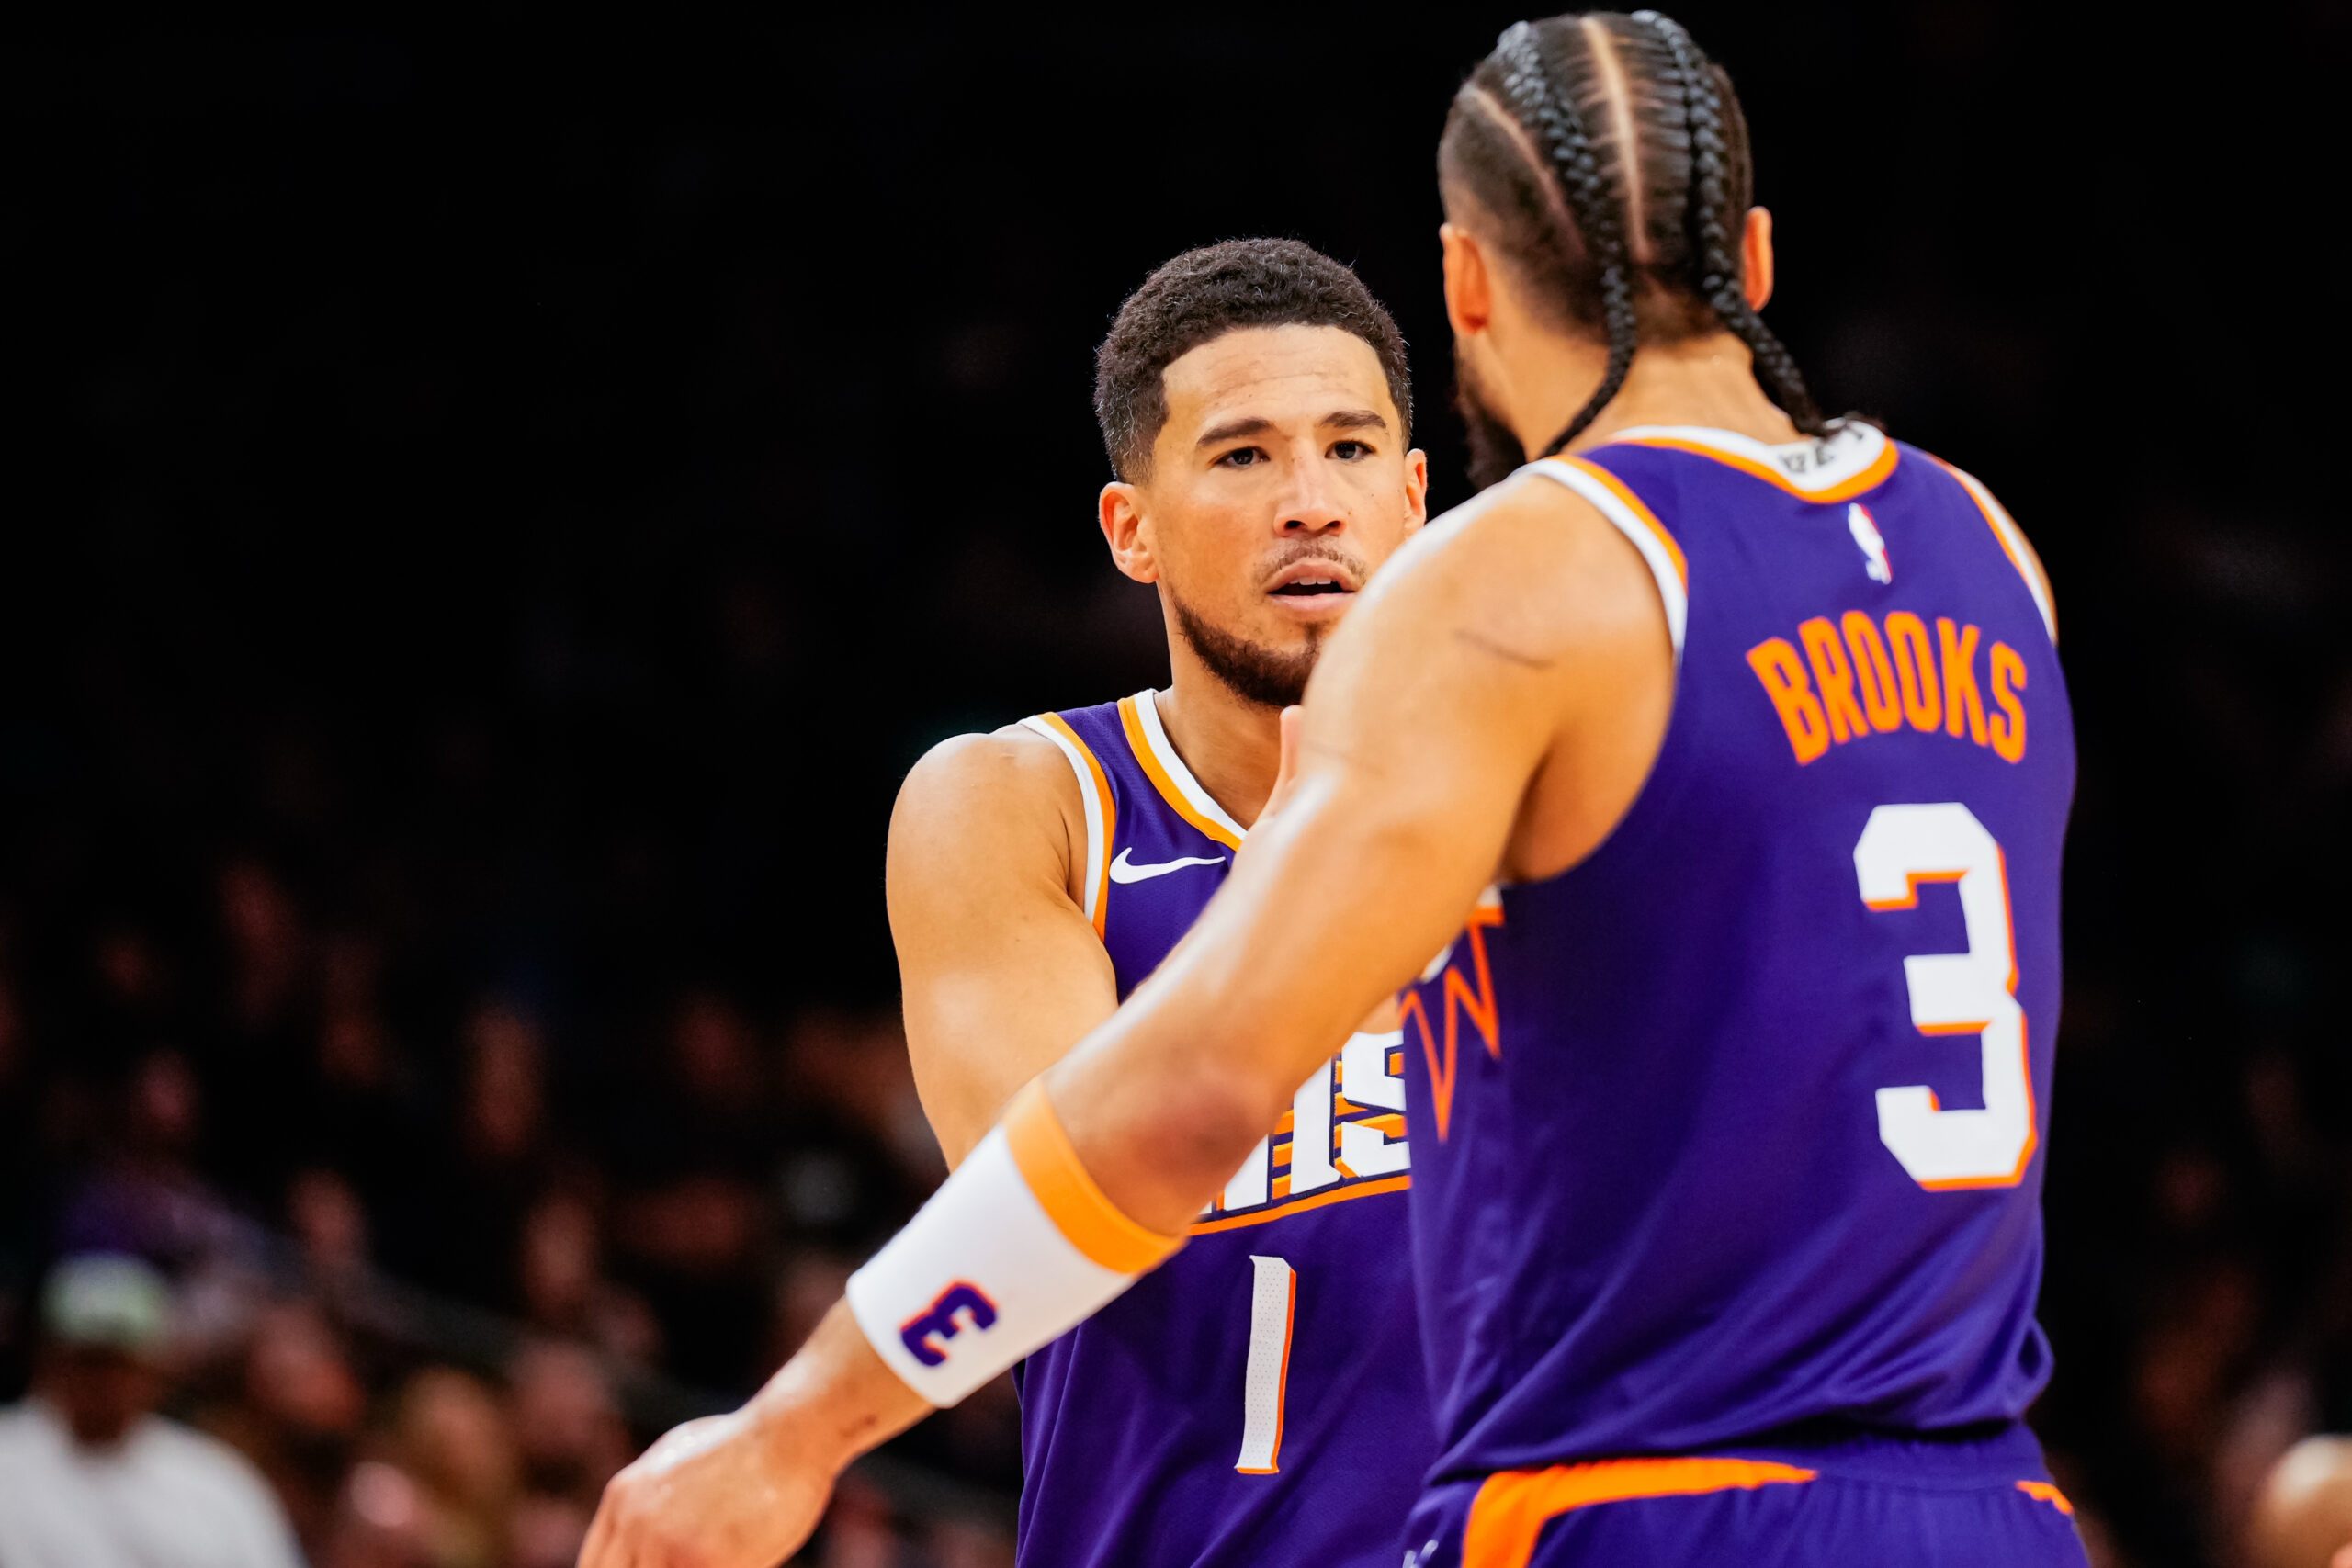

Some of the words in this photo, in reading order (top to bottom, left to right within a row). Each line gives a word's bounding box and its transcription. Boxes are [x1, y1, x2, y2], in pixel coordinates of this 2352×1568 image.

[1747, 610, 2027, 765] BROOKS
[1852, 802, 2038, 1191] 3
[899, 1279, 1000, 1367] 3
[1234, 1255, 1296, 1474] 1
